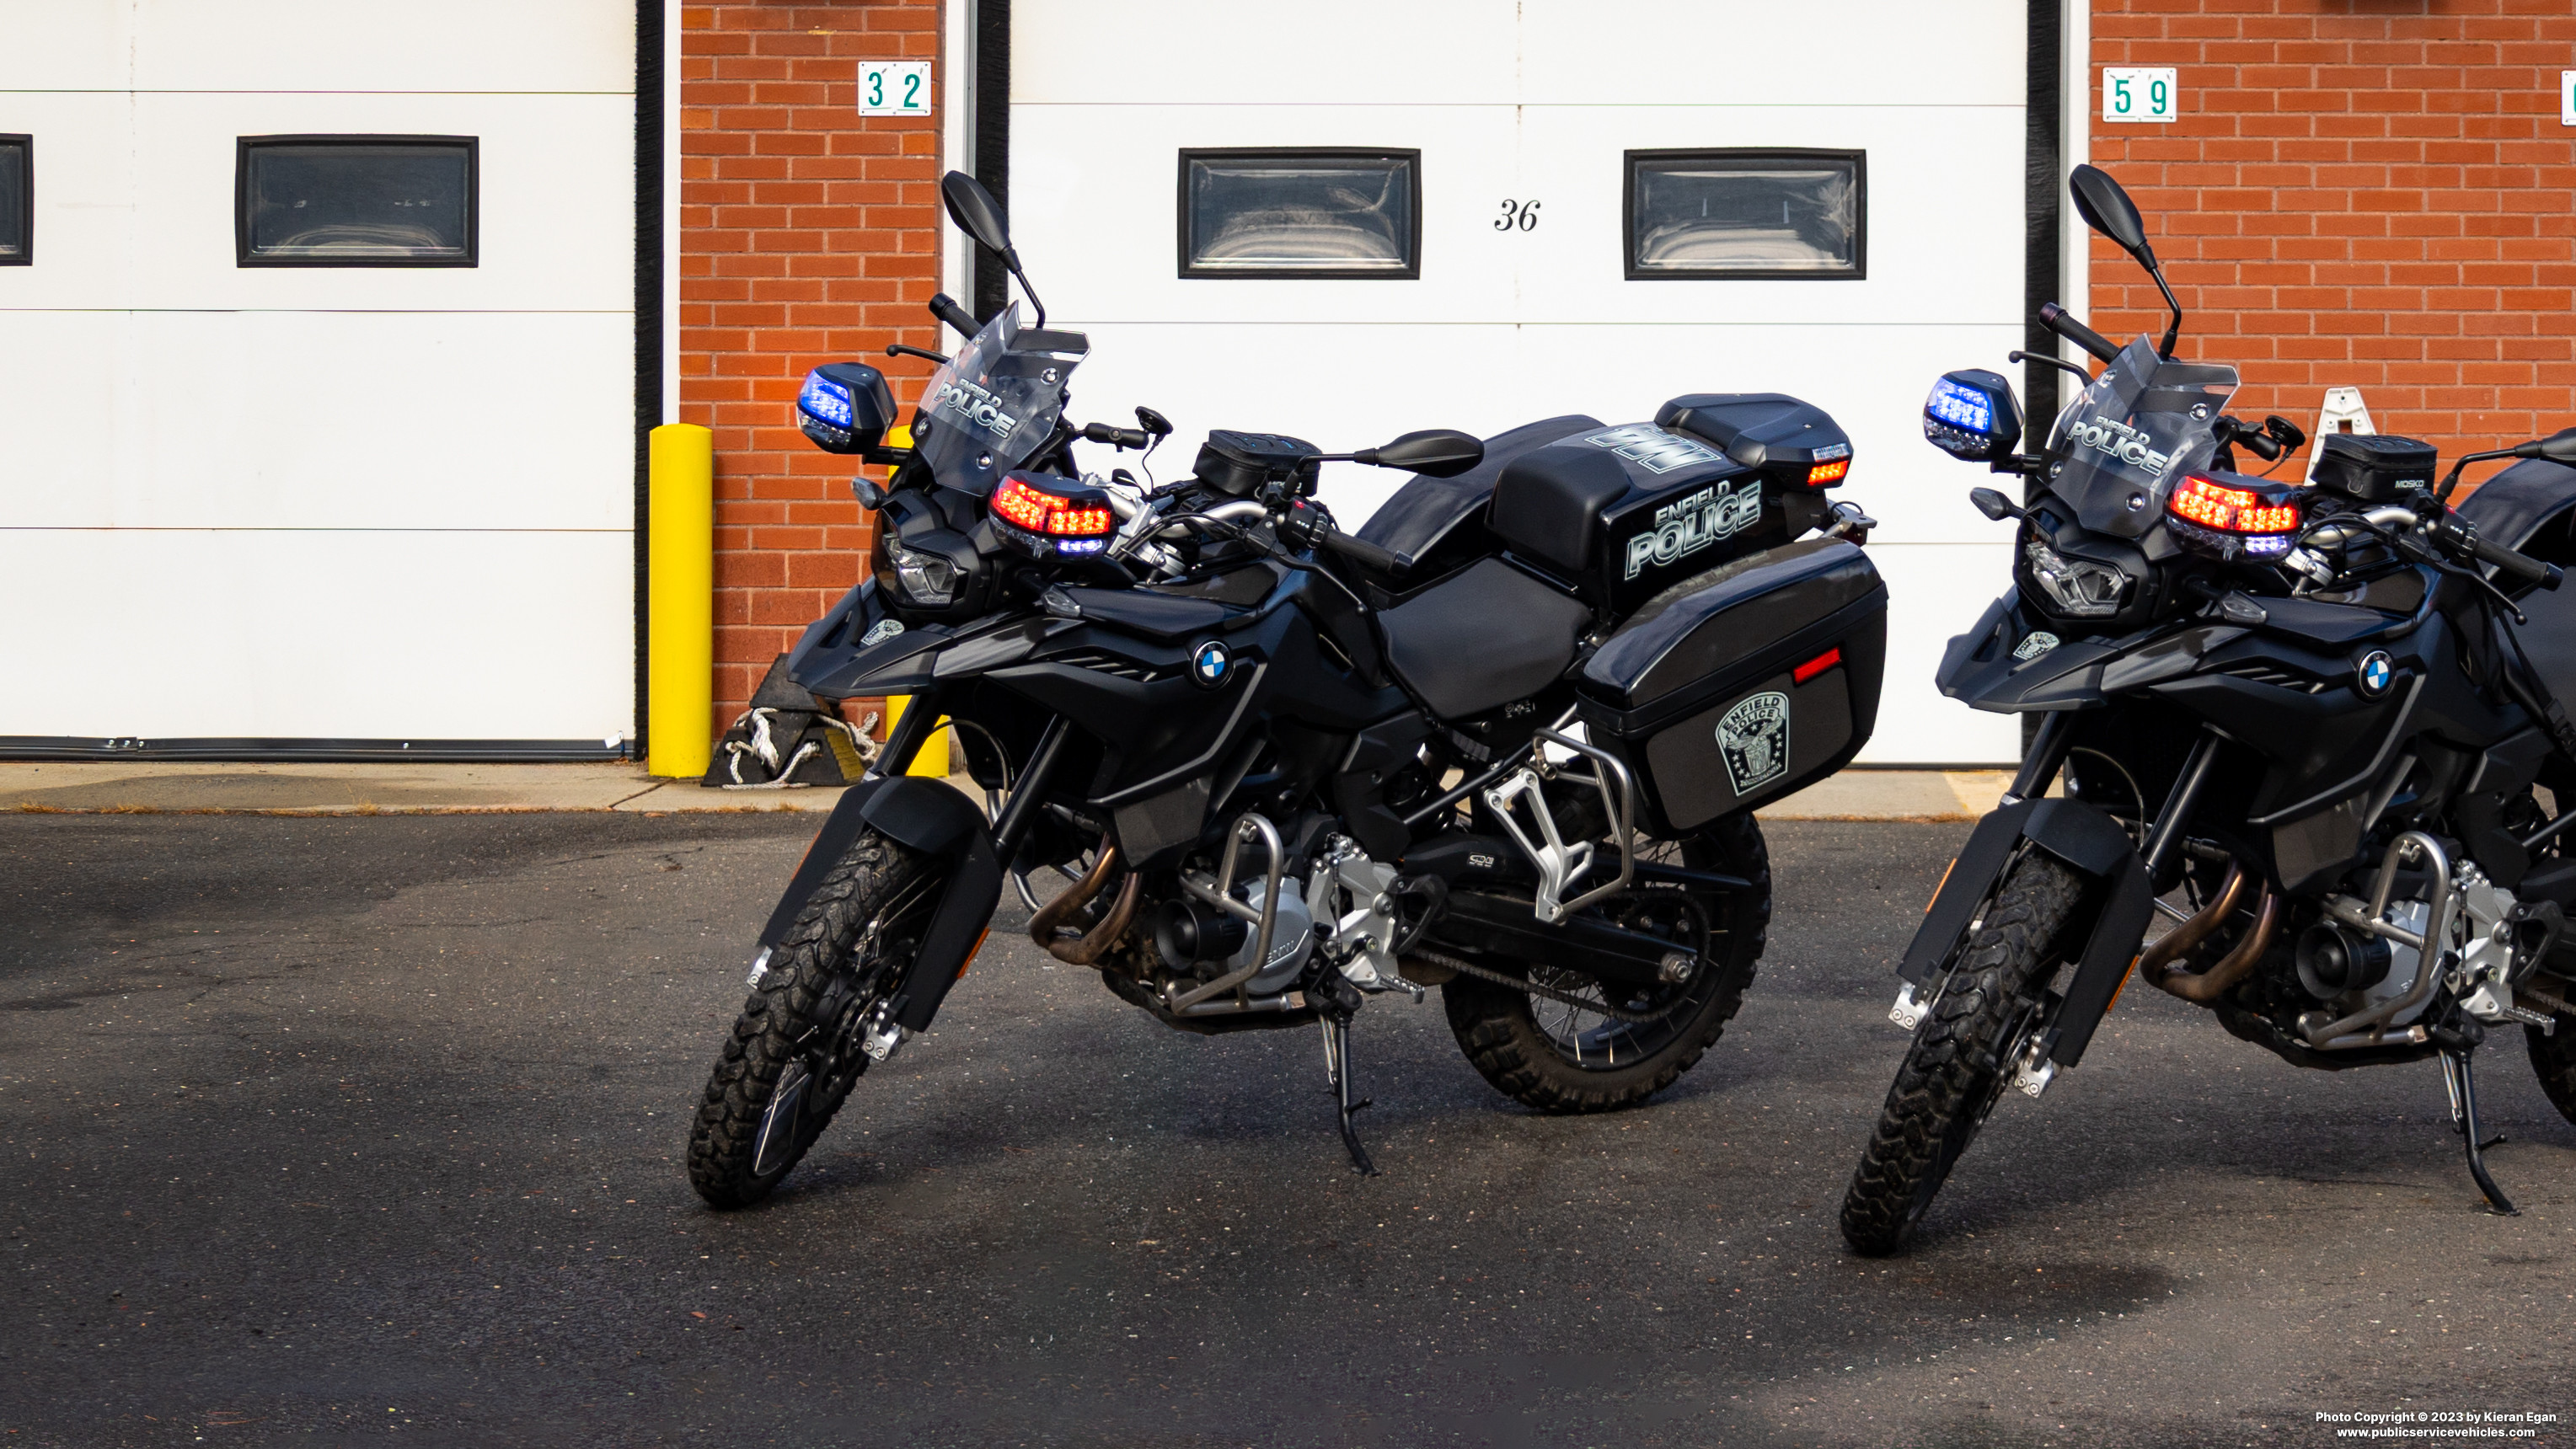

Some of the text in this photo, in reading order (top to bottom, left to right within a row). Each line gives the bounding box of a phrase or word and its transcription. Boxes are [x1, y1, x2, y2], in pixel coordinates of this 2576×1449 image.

[868, 72, 920, 108] 32
[2115, 79, 2166, 115] 59
[1494, 198, 1540, 232] 36
[959, 377, 1004, 408] ENFIELD
[934, 382, 1016, 439] POLICE
[2094, 415, 2150, 446] ENFIELD
[2066, 420, 2169, 477] POLICE
[2395, 479, 2424, 489] MOSKO
[1655, 479, 1731, 528] ENFIELD
[1625, 479, 1762, 580] POLICE
[1722, 697, 1781, 731] ENFIELD
[1731, 708, 1775, 735] POLICE
